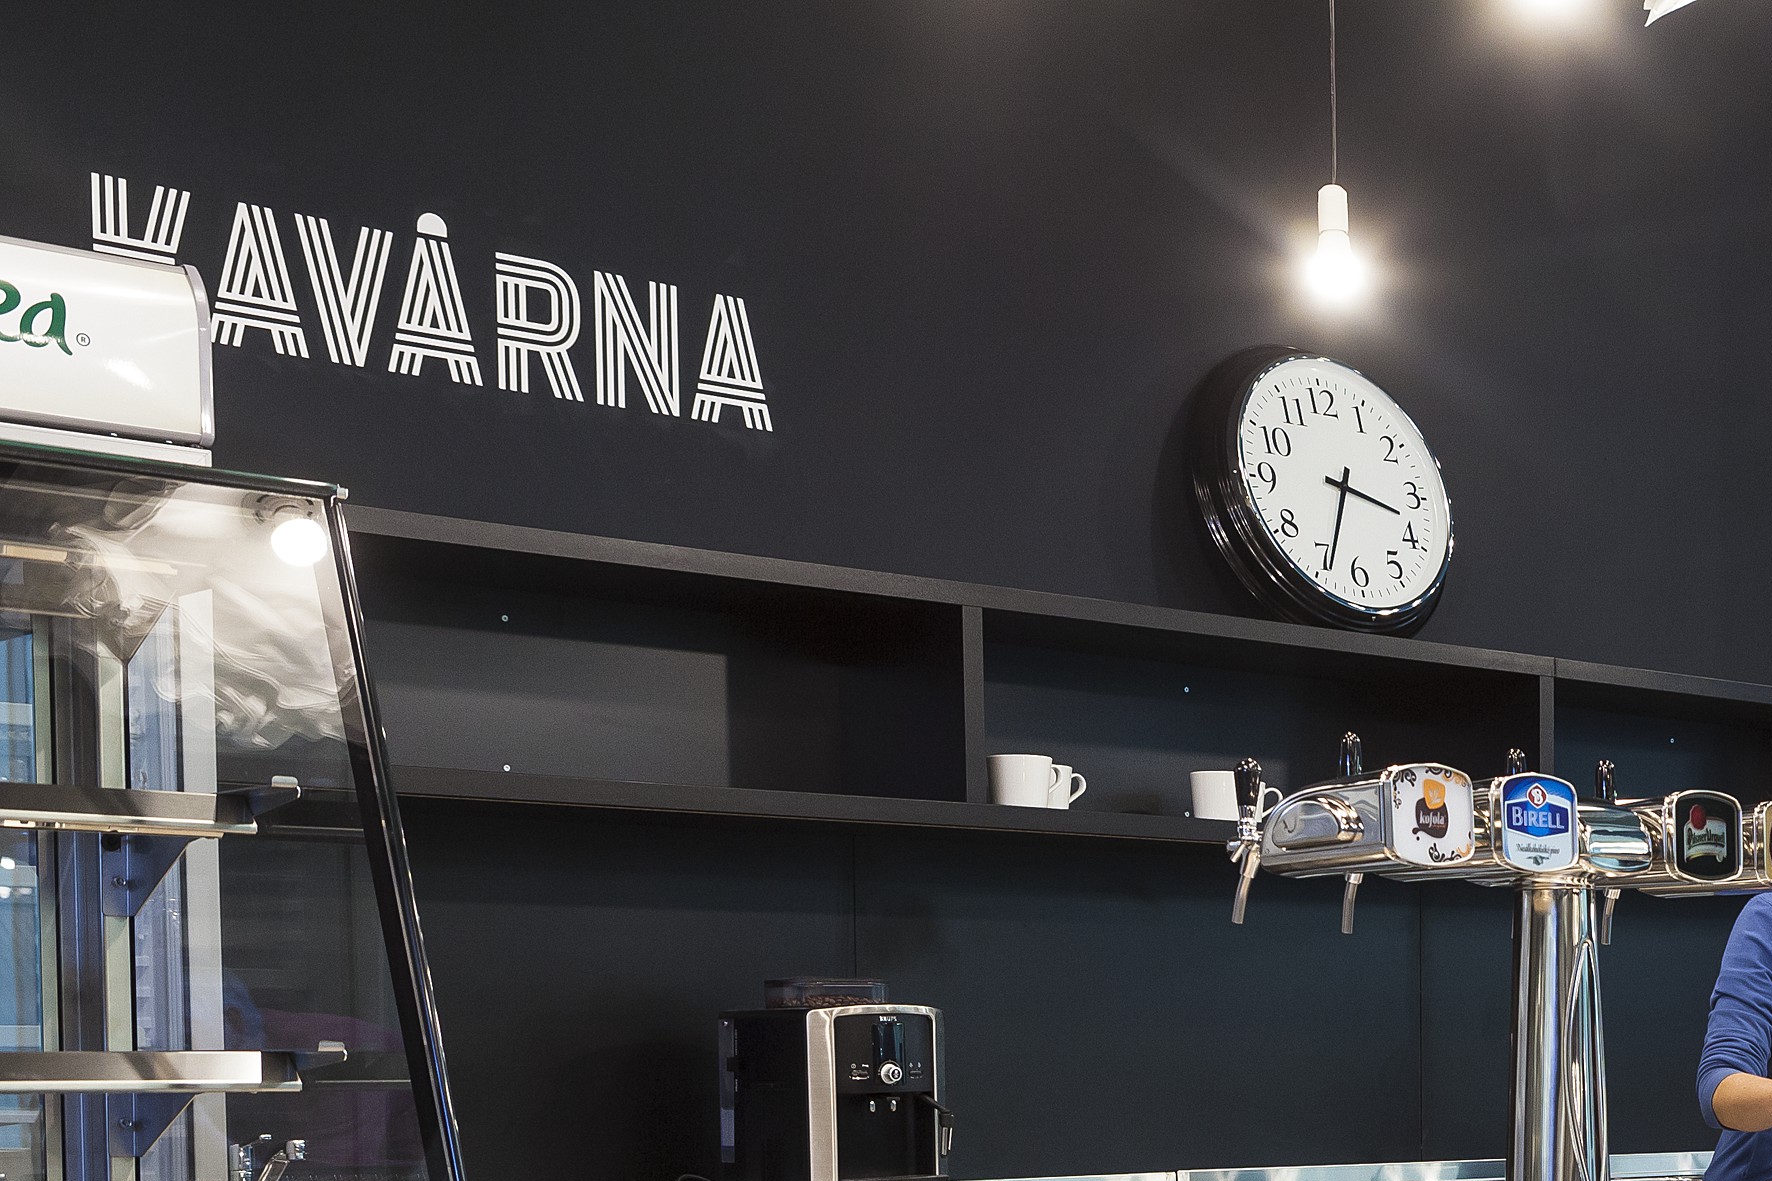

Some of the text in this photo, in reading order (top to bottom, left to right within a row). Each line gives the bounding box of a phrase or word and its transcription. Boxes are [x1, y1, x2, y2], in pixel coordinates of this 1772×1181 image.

[1280, 395, 1308, 427] 11
[1306, 387, 1339, 421] 12
[1352, 405, 1367, 434] 1
[1260, 425, 1292, 457] 10
[1379, 435, 1399, 465] 2
[1257, 462, 1277, 494] 9
[1403, 481, 1421, 509] 3
[1280, 508, 1299, 538] 8
[1402, 520, 1419, 550] 4
[1314, 540, 1330, 571] 7
[1386, 550, 1403, 580] 5
[1350, 555, 1369, 588] 6
[1420, 811, 1445, 828] kofola
[1512, 806, 1565, 829] BIRELL
